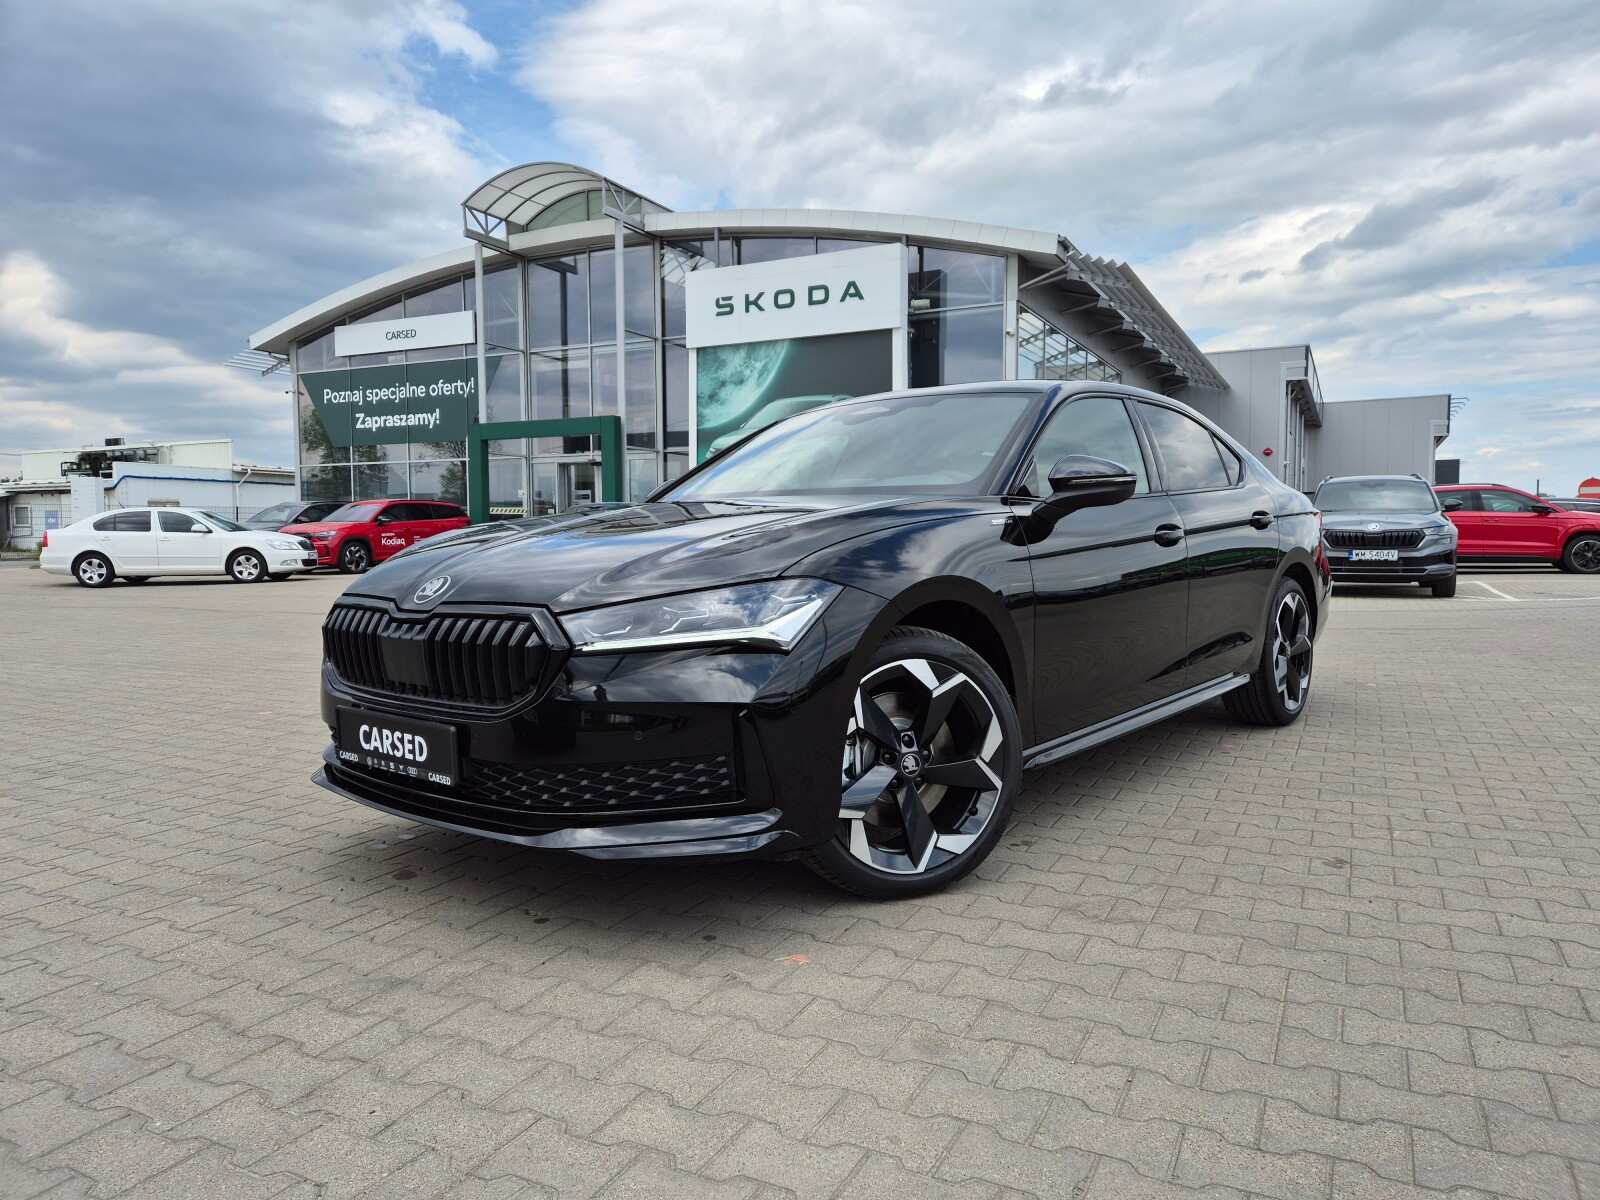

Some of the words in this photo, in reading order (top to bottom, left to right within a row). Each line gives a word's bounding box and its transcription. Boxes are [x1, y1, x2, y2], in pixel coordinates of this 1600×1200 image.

[385, 328, 417, 341] CARSED
[323, 385, 363, 406] Poznaj
[366, 382, 426, 405] specjalne
[429, 376, 475, 398] oferty!
[355, 408, 440, 432] Zapraszamy!
[381, 537, 405, 546] Kodiaq
[359, 724, 428, 762] CARSED
[339, 750, 359, 762] CARSED
[428, 772, 451, 786] CARSED
